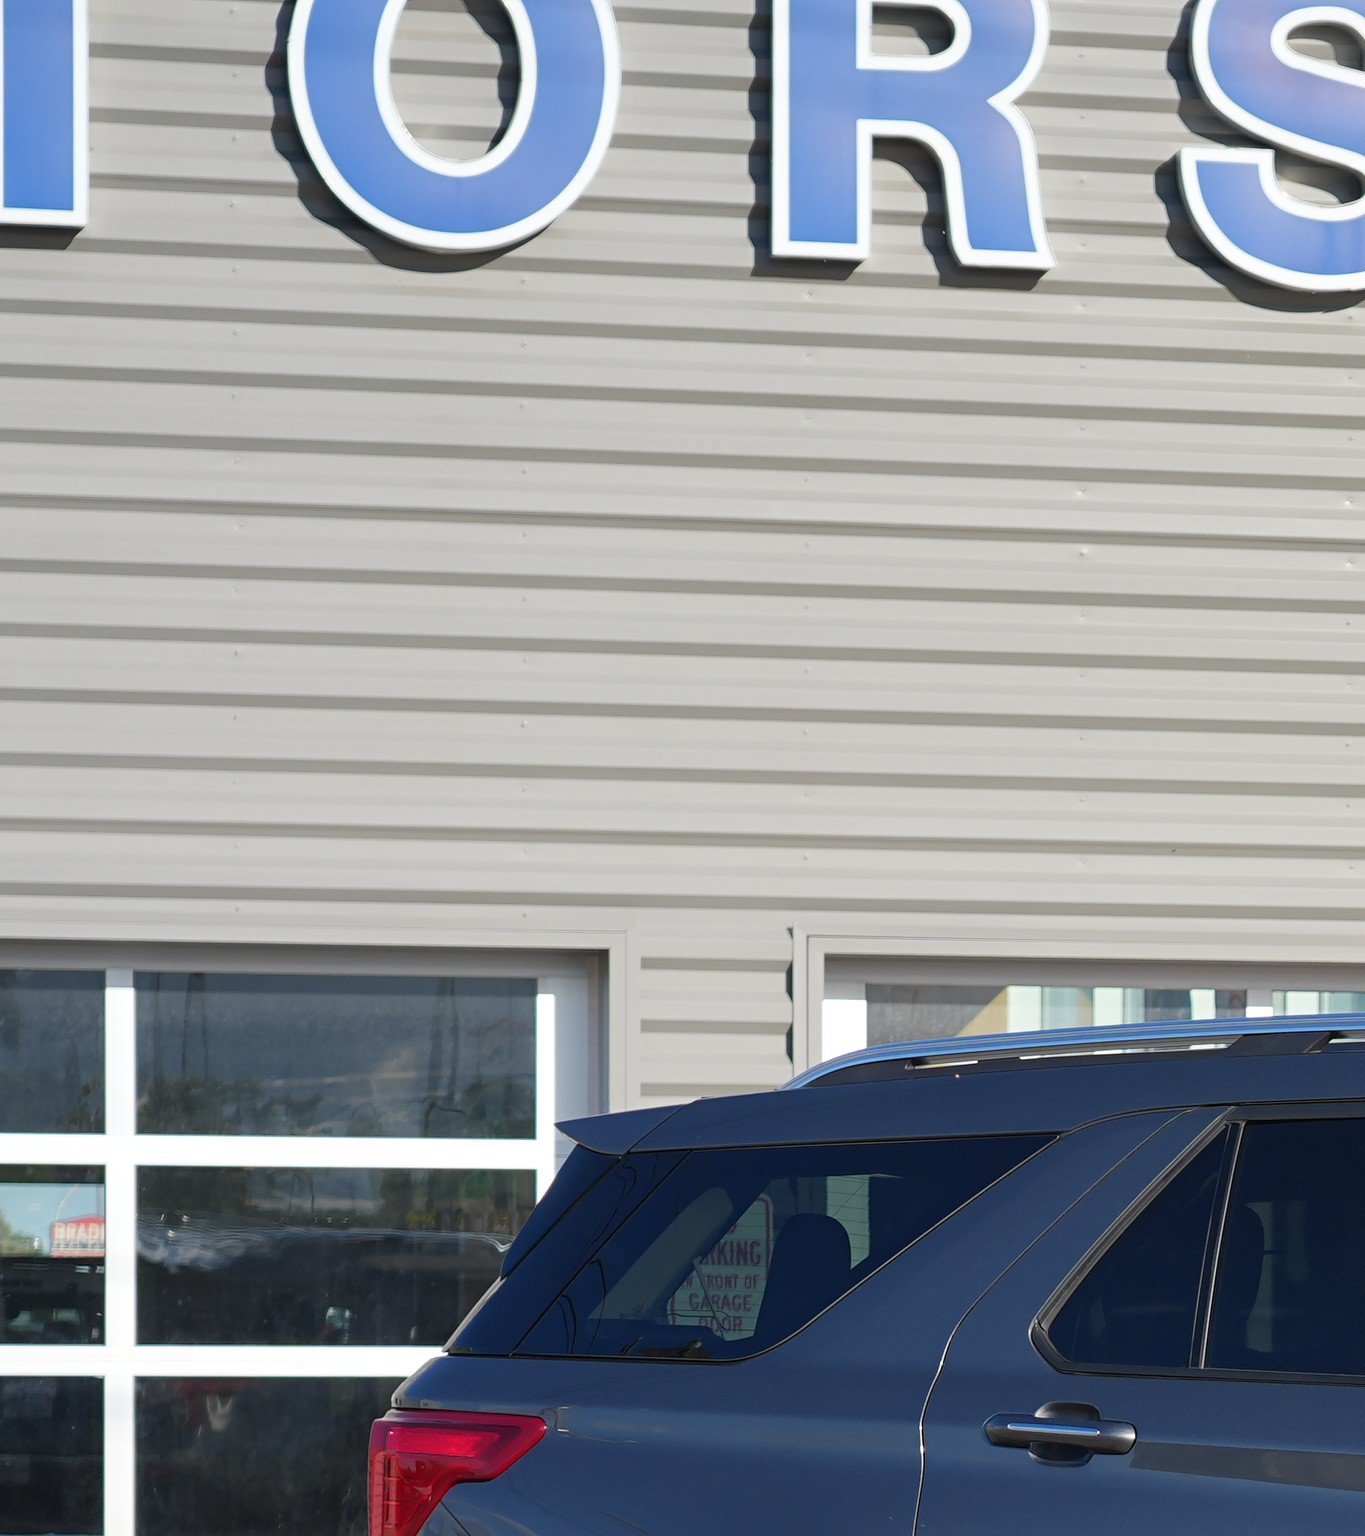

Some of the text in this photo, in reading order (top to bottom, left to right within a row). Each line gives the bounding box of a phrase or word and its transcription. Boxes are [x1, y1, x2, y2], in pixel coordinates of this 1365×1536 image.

[54, 1221, 105, 1243] BRAD
[706, 1273, 739, 1289] RONT
[744, 1273, 761, 1290] OF
[688, 1292, 753, 1312] GARAGE
